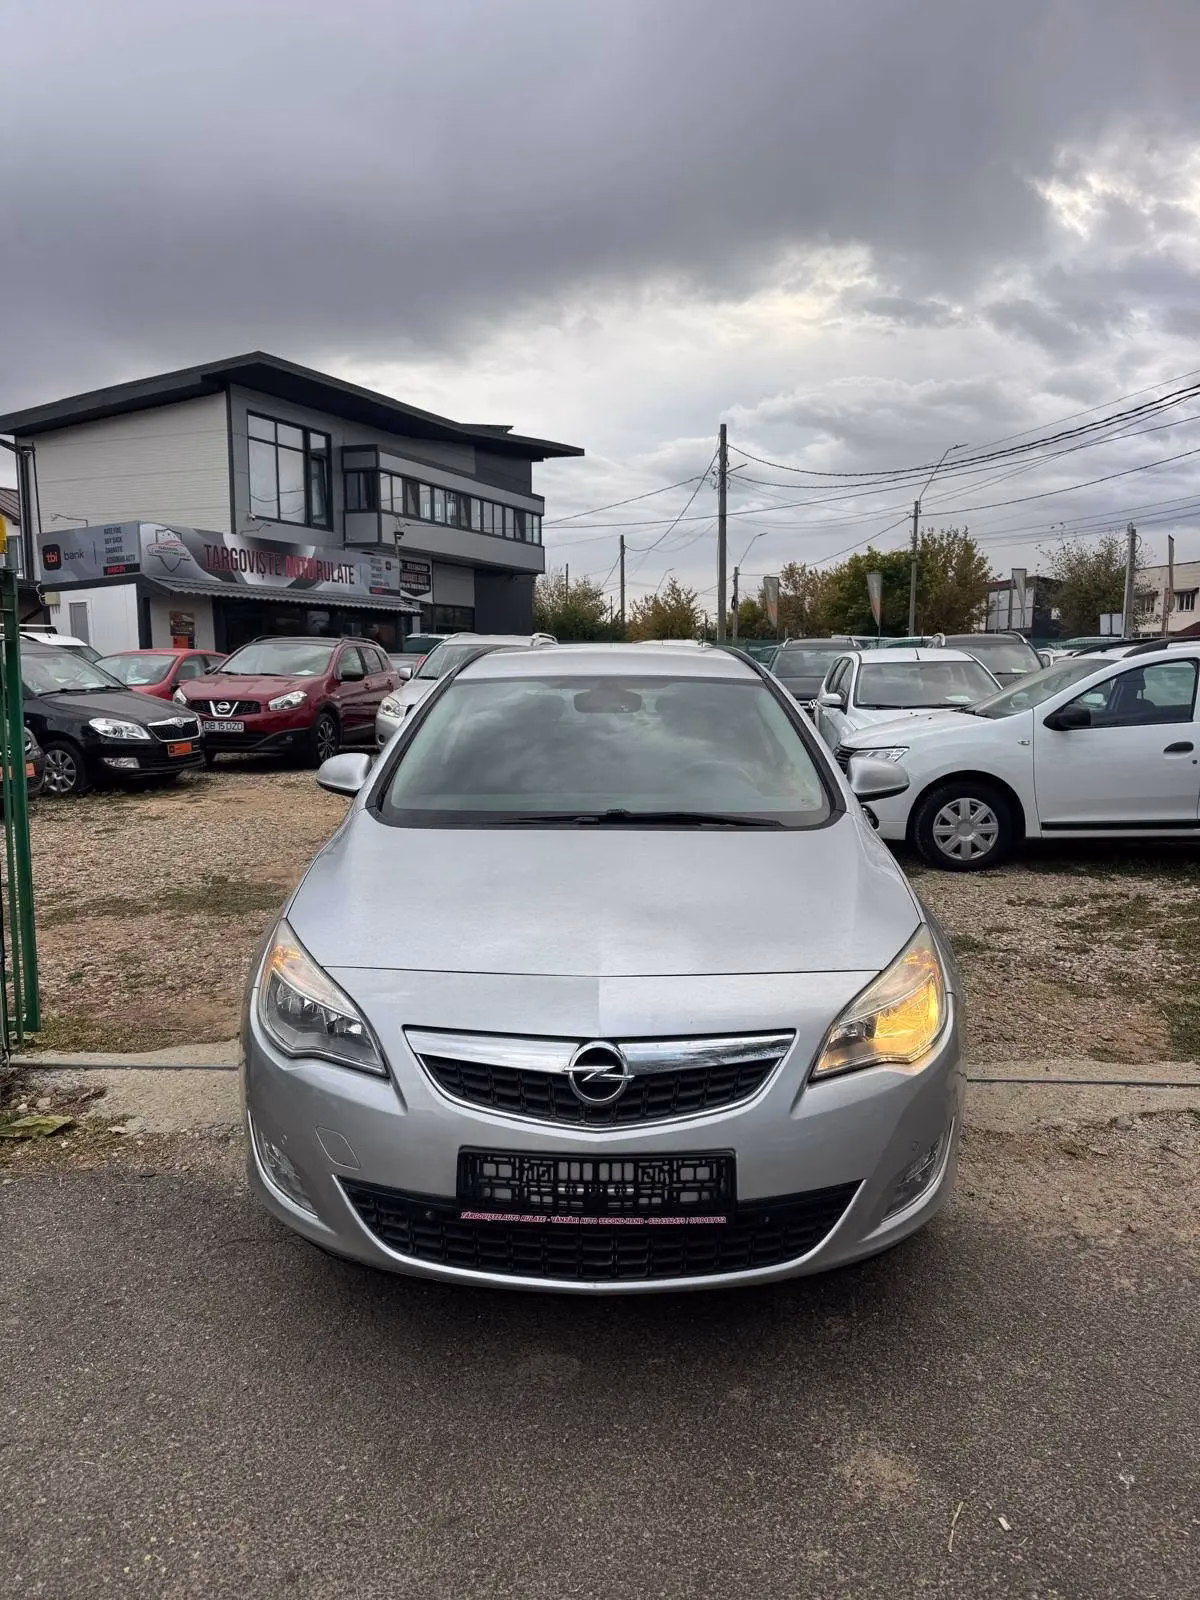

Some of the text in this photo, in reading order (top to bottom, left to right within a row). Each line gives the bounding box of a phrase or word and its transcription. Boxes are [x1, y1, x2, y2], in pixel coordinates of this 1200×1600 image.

[47, 548, 84, 563] tbi bank
[580, 1216, 598, 1224] AUTO
